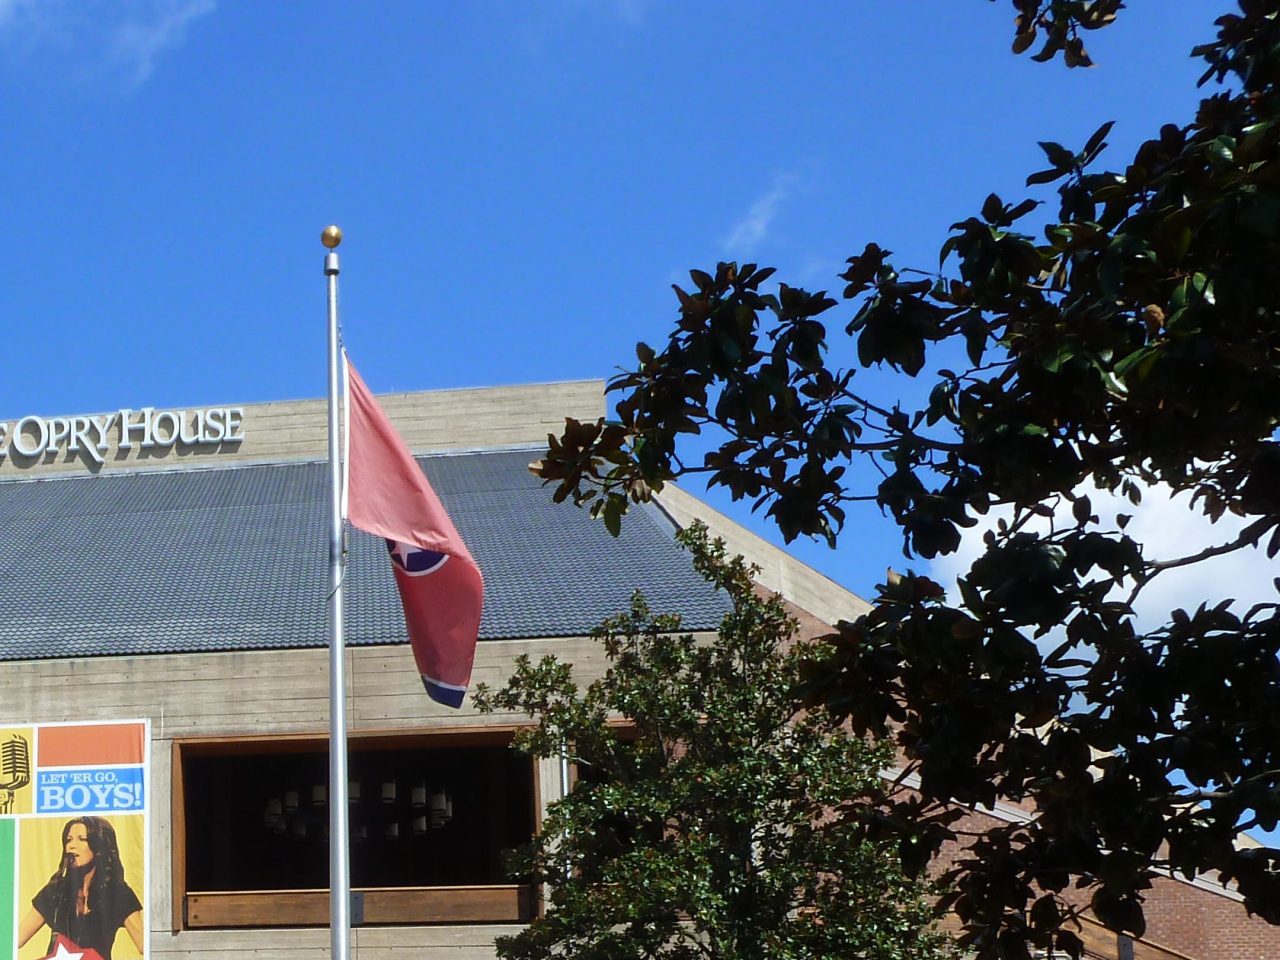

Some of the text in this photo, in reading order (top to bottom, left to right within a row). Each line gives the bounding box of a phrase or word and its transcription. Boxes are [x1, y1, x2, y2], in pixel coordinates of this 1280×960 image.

[13, 414, 117, 464] OPRY
[118, 407, 245, 449] HOUSE
[41, 772, 67, 785] LET
[95, 770, 118, 784] GO,
[41, 782, 142, 811] BOYS!
